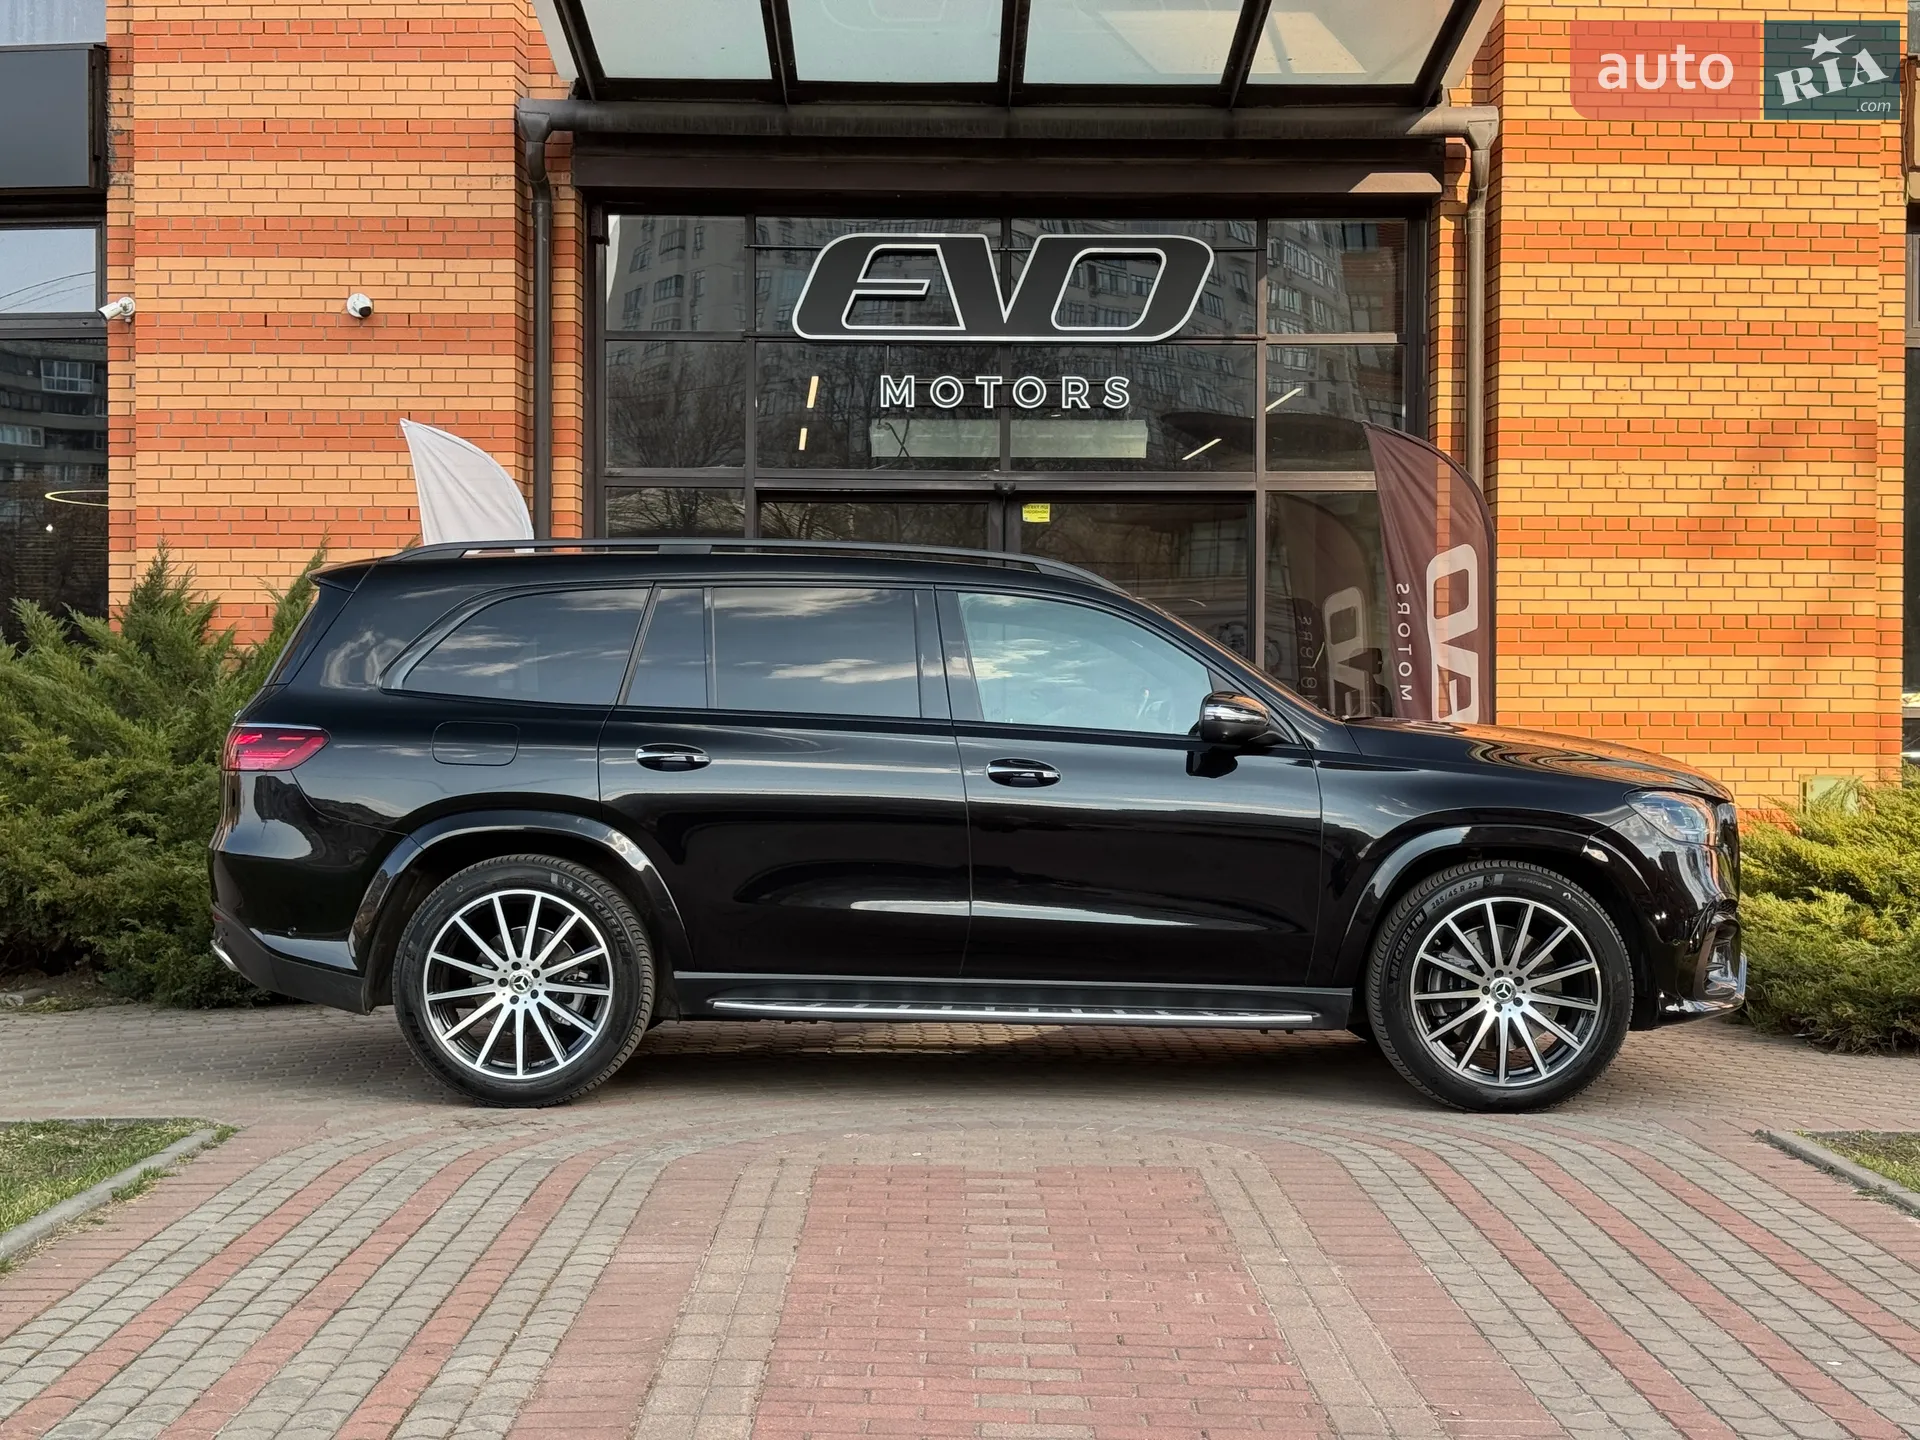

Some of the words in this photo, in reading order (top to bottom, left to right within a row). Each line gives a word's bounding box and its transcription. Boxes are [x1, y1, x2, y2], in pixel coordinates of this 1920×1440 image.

[792, 233, 1215, 343] EVO
[879, 374, 1130, 410] MOTORS
[576, 887, 631, 954] MICHELIN
[1460, 885, 1466, 893] R
[1468, 881, 1478, 890] 22
[1389, 911, 1425, 979] MICHELIN
